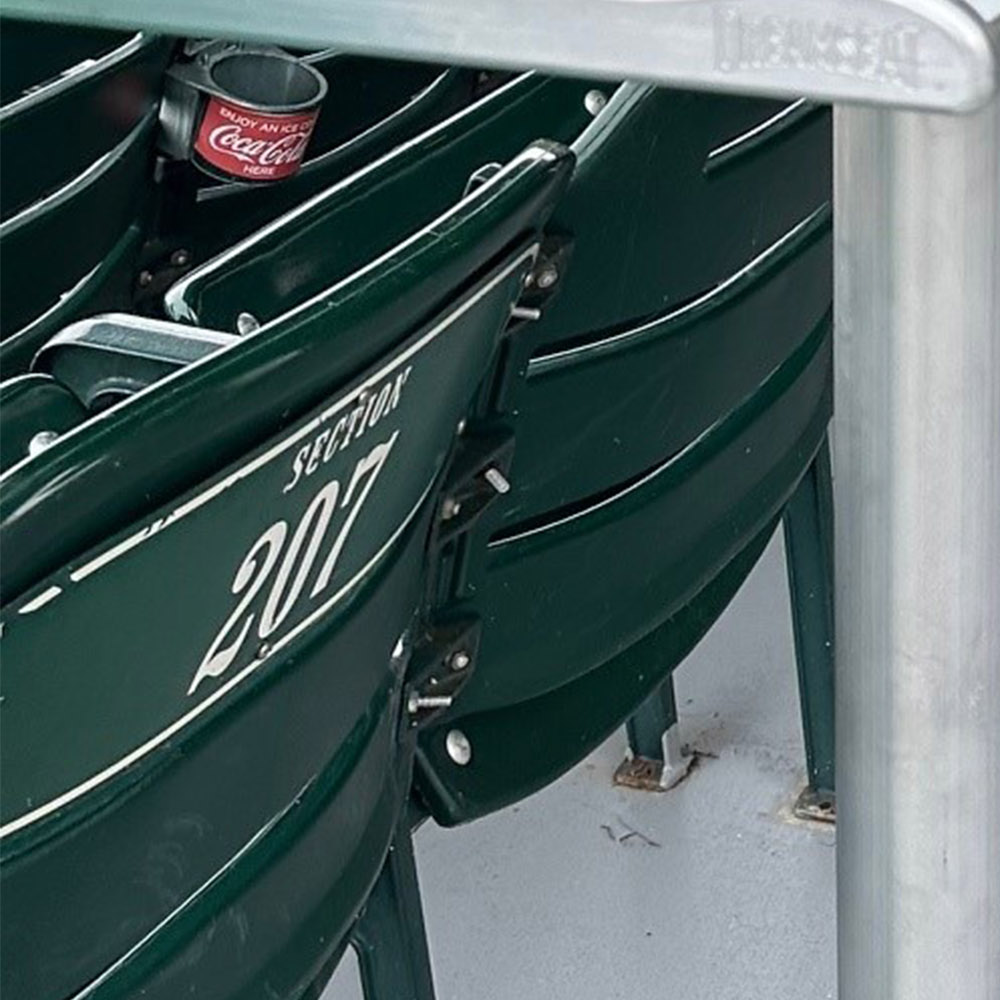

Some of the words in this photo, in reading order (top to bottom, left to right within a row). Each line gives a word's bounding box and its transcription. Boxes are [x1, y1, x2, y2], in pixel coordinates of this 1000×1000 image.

[220, 107, 259, 128] ENJOY
[259, 123, 278, 133] AN
[208, 125, 308, 165] Coca-Cola
[243, 165, 275, 176] HERE
[282, 366, 413, 495] SECTION
[187, 429, 400, 697] 207
